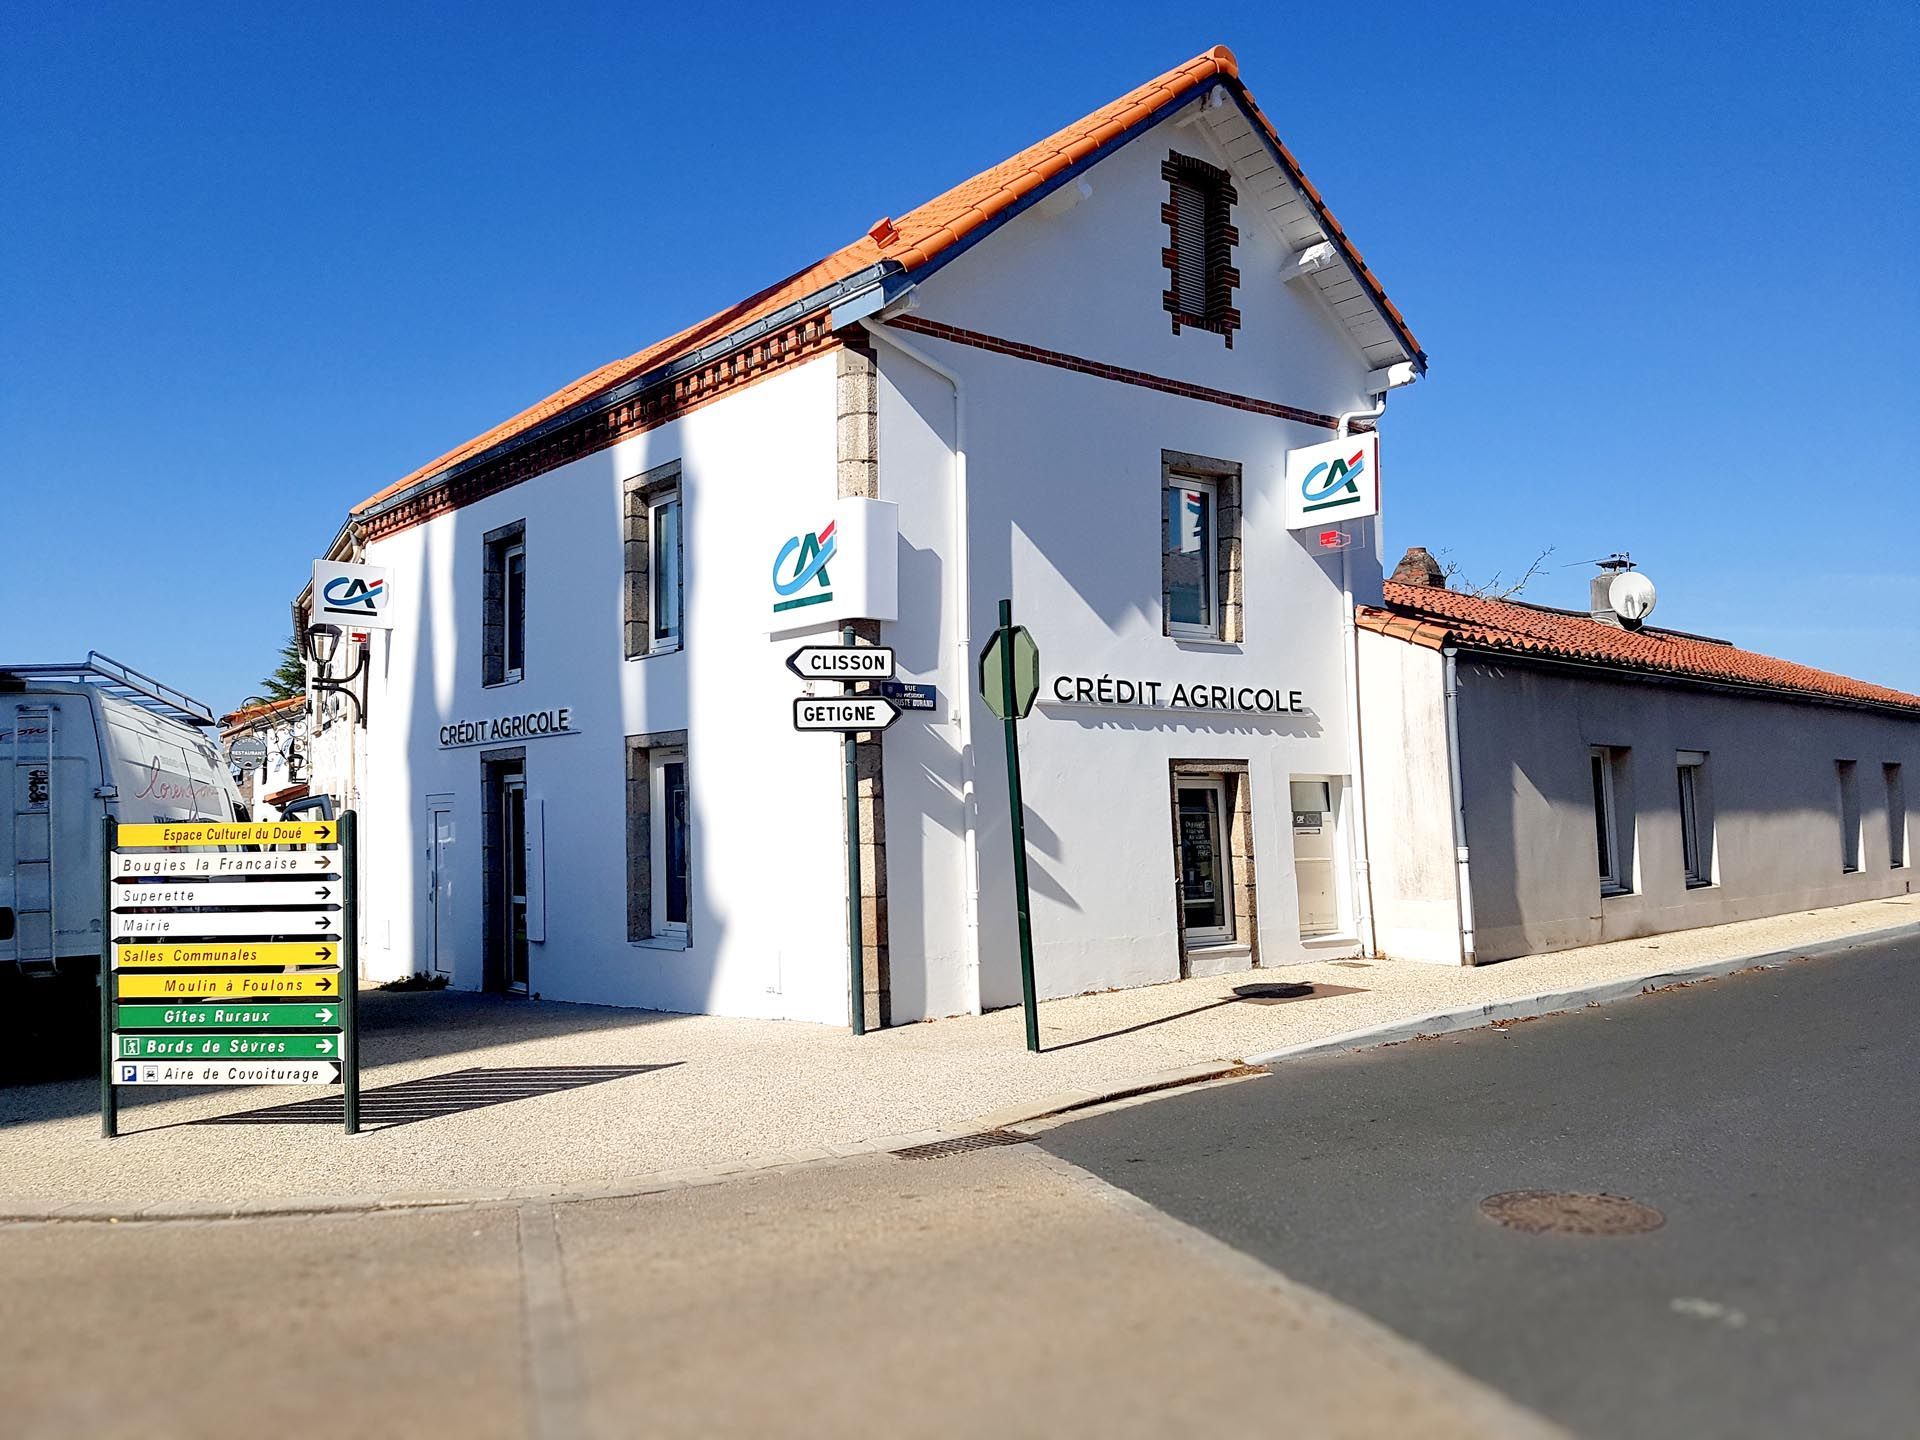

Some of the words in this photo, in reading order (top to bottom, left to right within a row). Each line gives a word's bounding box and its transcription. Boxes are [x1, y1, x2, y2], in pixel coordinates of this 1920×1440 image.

[811, 655, 885, 670] CLISSON
[1053, 674, 1162, 706] CRÉDIT
[1170, 683, 1303, 713] AGRICOLE
[804, 706, 875, 721] GETIGNE
[440, 720, 488, 745] CRÉDIT
[491, 708, 569, 739] AGRICOLE
[164, 828, 202, 844] Espace
[207, 828, 251, 840] Culturel
[256, 827, 269, 839] du
[273, 826, 302, 839] Doué
[123, 859, 186, 873] Bougies
[197, 857, 209, 870] la
[220, 857, 297, 870] Française
[123, 889, 194, 904] Superette
[123, 919, 170, 931] Mairie
[124, 950, 163, 962] Salles
[174, 949, 257, 961] Communales
[164, 979, 216, 992] Moulin
[226, 979, 232, 991] à
[243, 979, 303, 991] Foulons
[164, 1010, 205, 1023] Gîtes
[215, 1010, 270, 1023] Ruraux
[147, 1040, 193, 1053] Bords
[202, 1040, 219, 1052] de
[230, 1039, 285, 1052] Sèvres
[164, 1067, 195, 1079] Aire
[203, 1067, 218, 1079] de
[228, 1066, 318, 1080] Covoiturage
